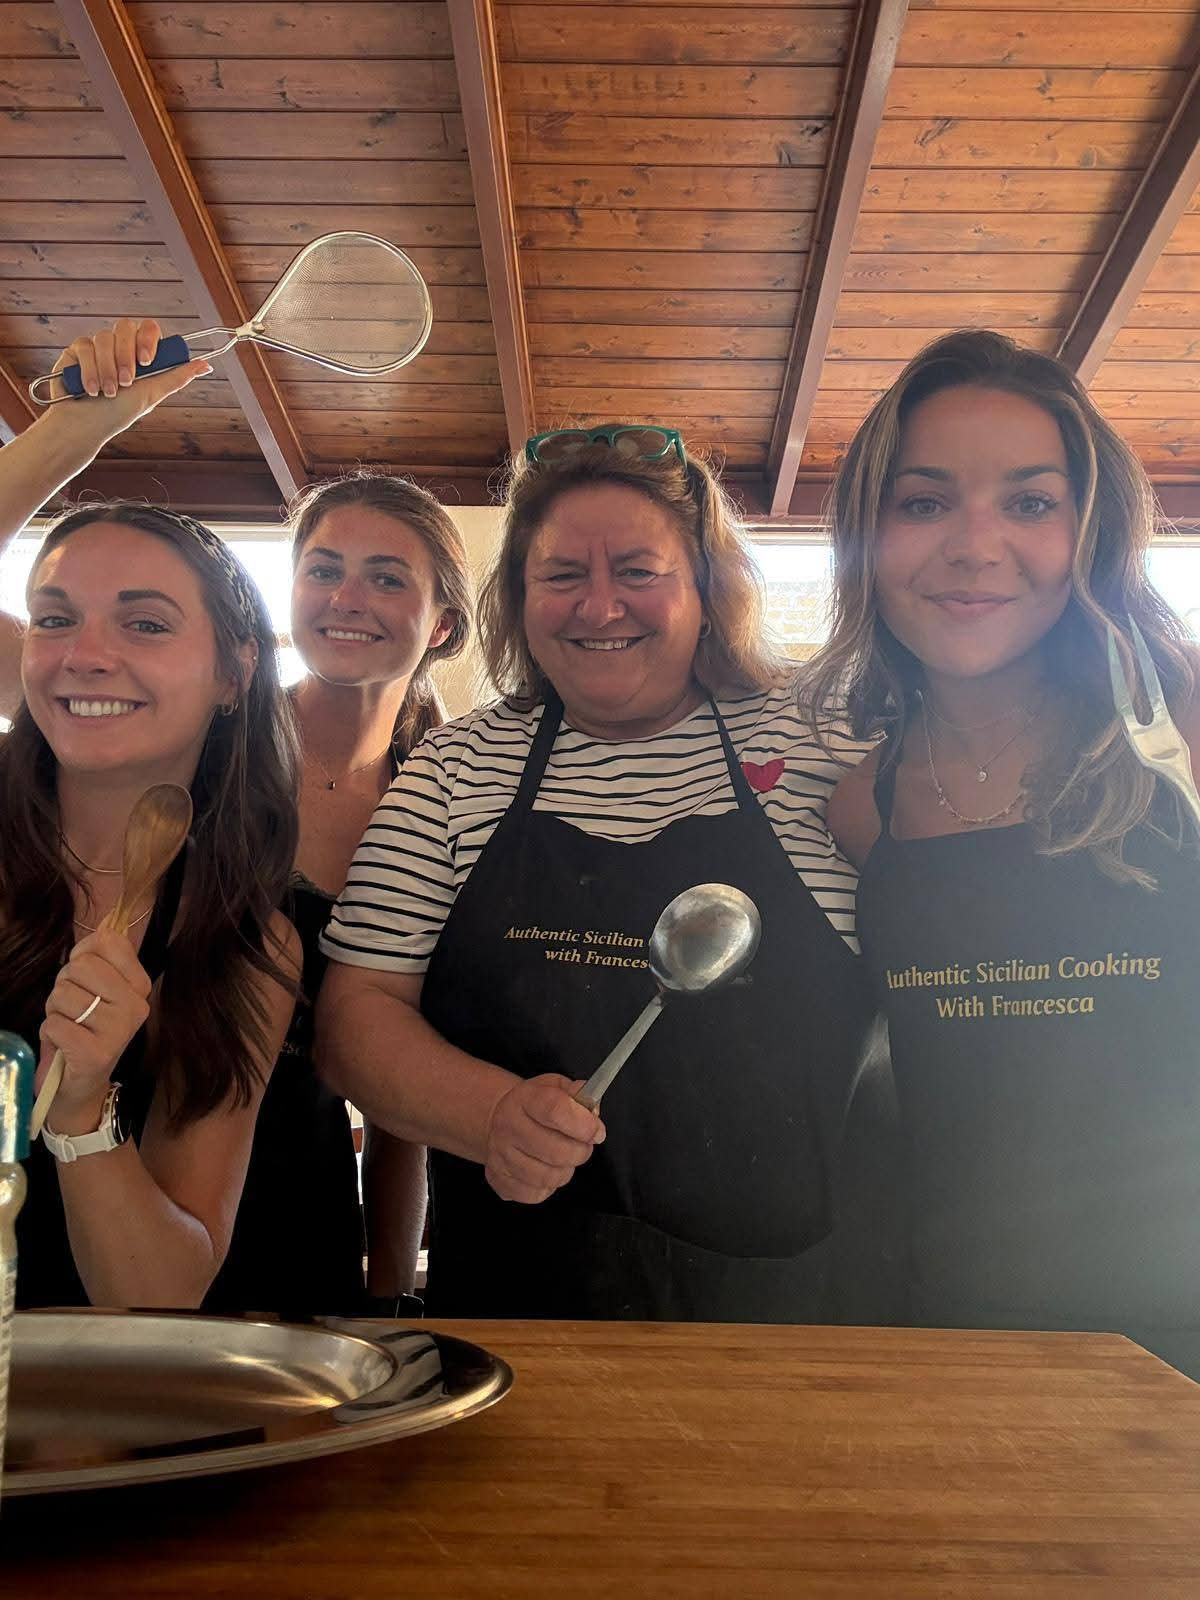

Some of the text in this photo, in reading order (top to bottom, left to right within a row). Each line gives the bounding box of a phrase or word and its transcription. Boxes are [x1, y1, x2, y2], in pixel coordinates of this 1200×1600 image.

[504, 926, 580, 943] Authentic
[583, 930, 644, 948] Sicilian
[545, 948, 652, 969] with Frances
[976, 959, 1050, 985] Sicilian
[1057, 952, 1162, 981] Cooking
[936, 995, 1095, 1018] With Francesca
